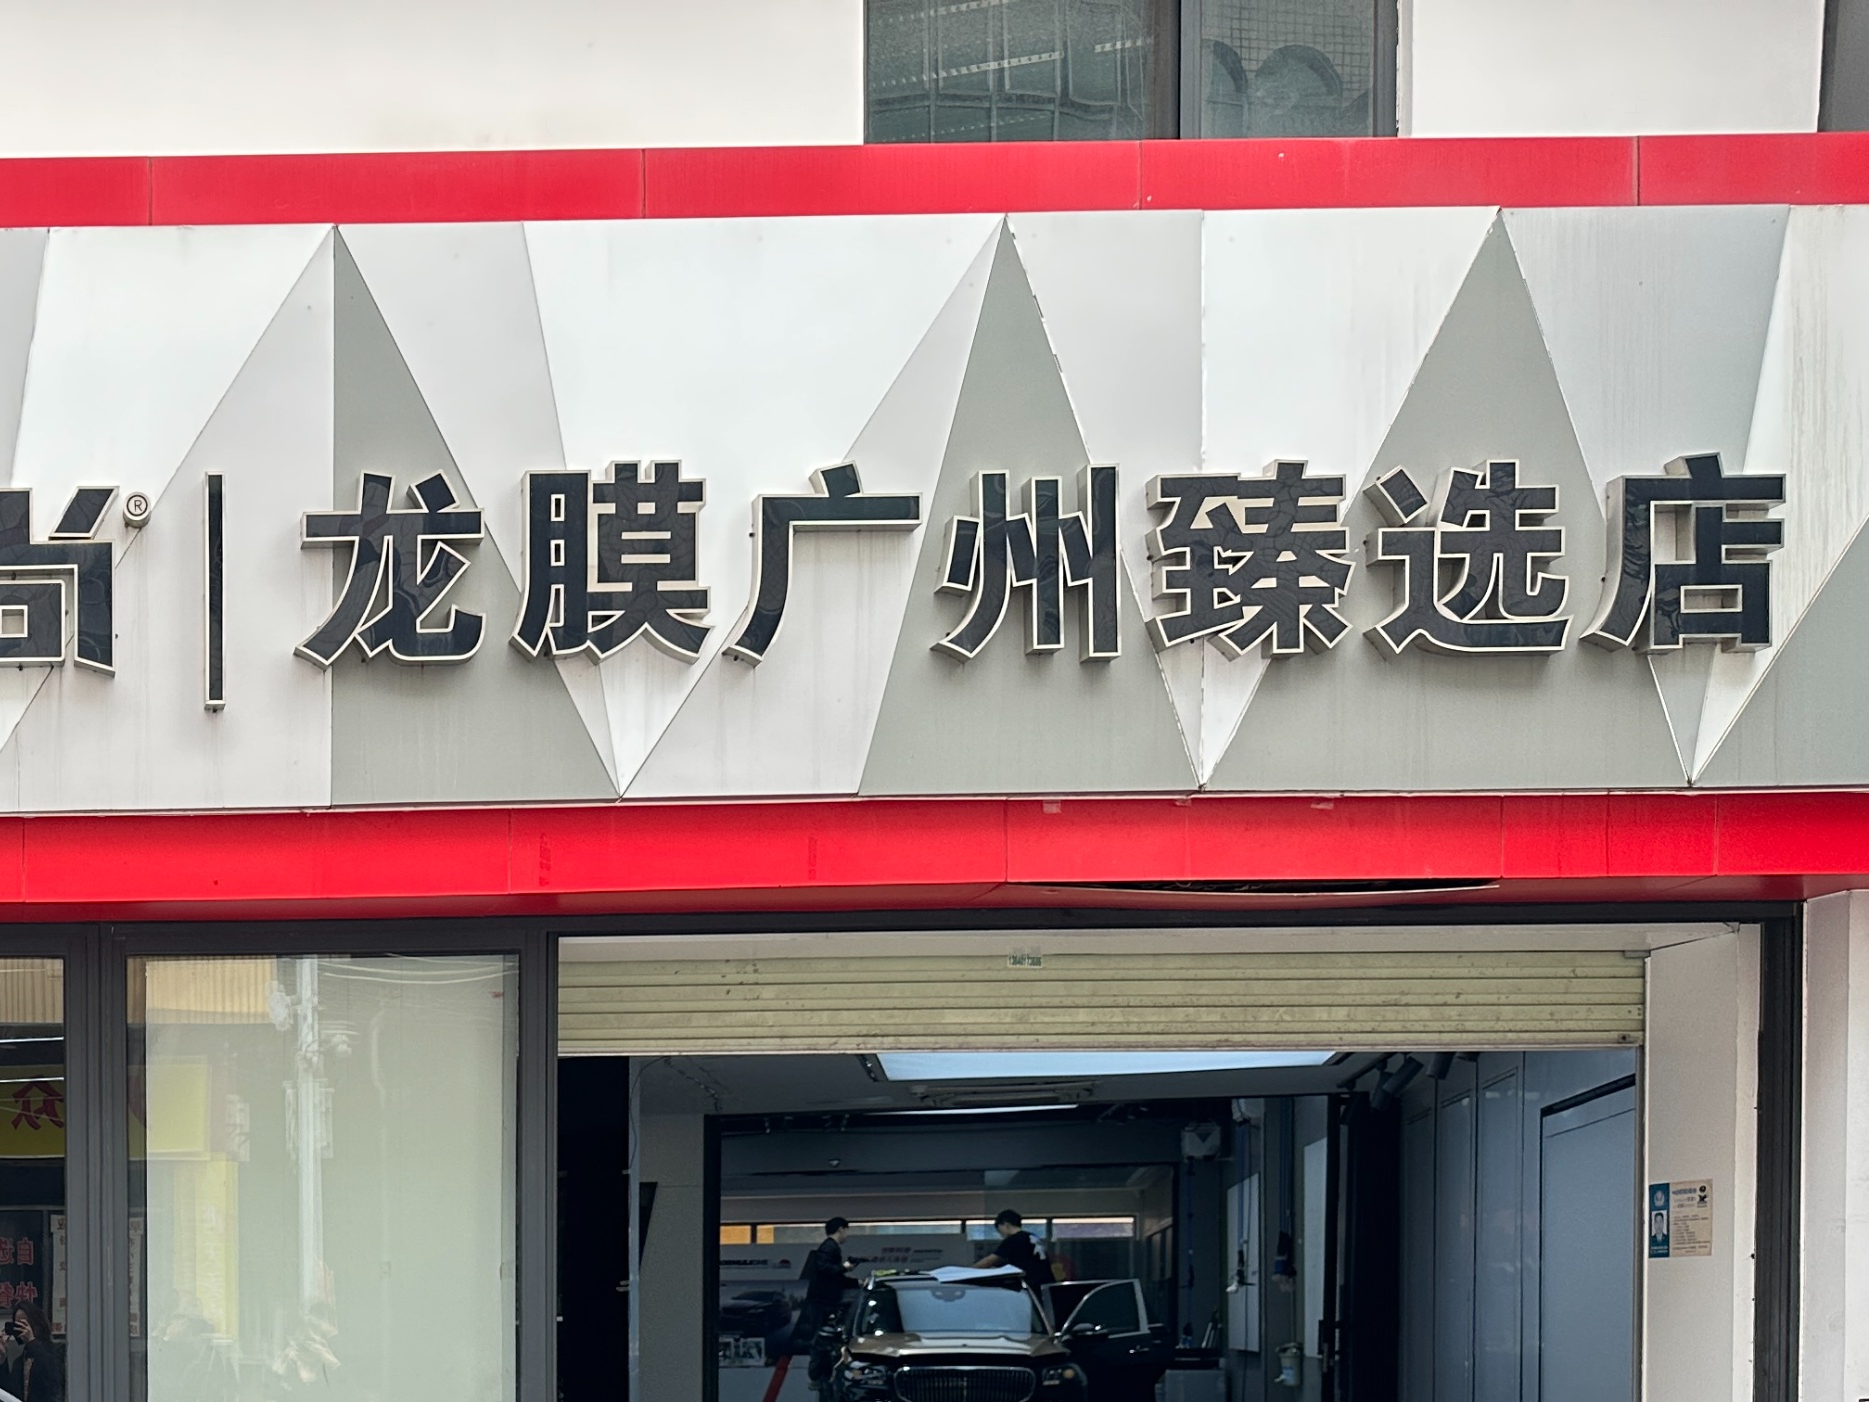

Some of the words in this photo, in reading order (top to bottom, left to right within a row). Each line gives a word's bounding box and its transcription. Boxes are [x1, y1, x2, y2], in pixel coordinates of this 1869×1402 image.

[294, 452, 1787, 670] 龙膜广州臻选店
